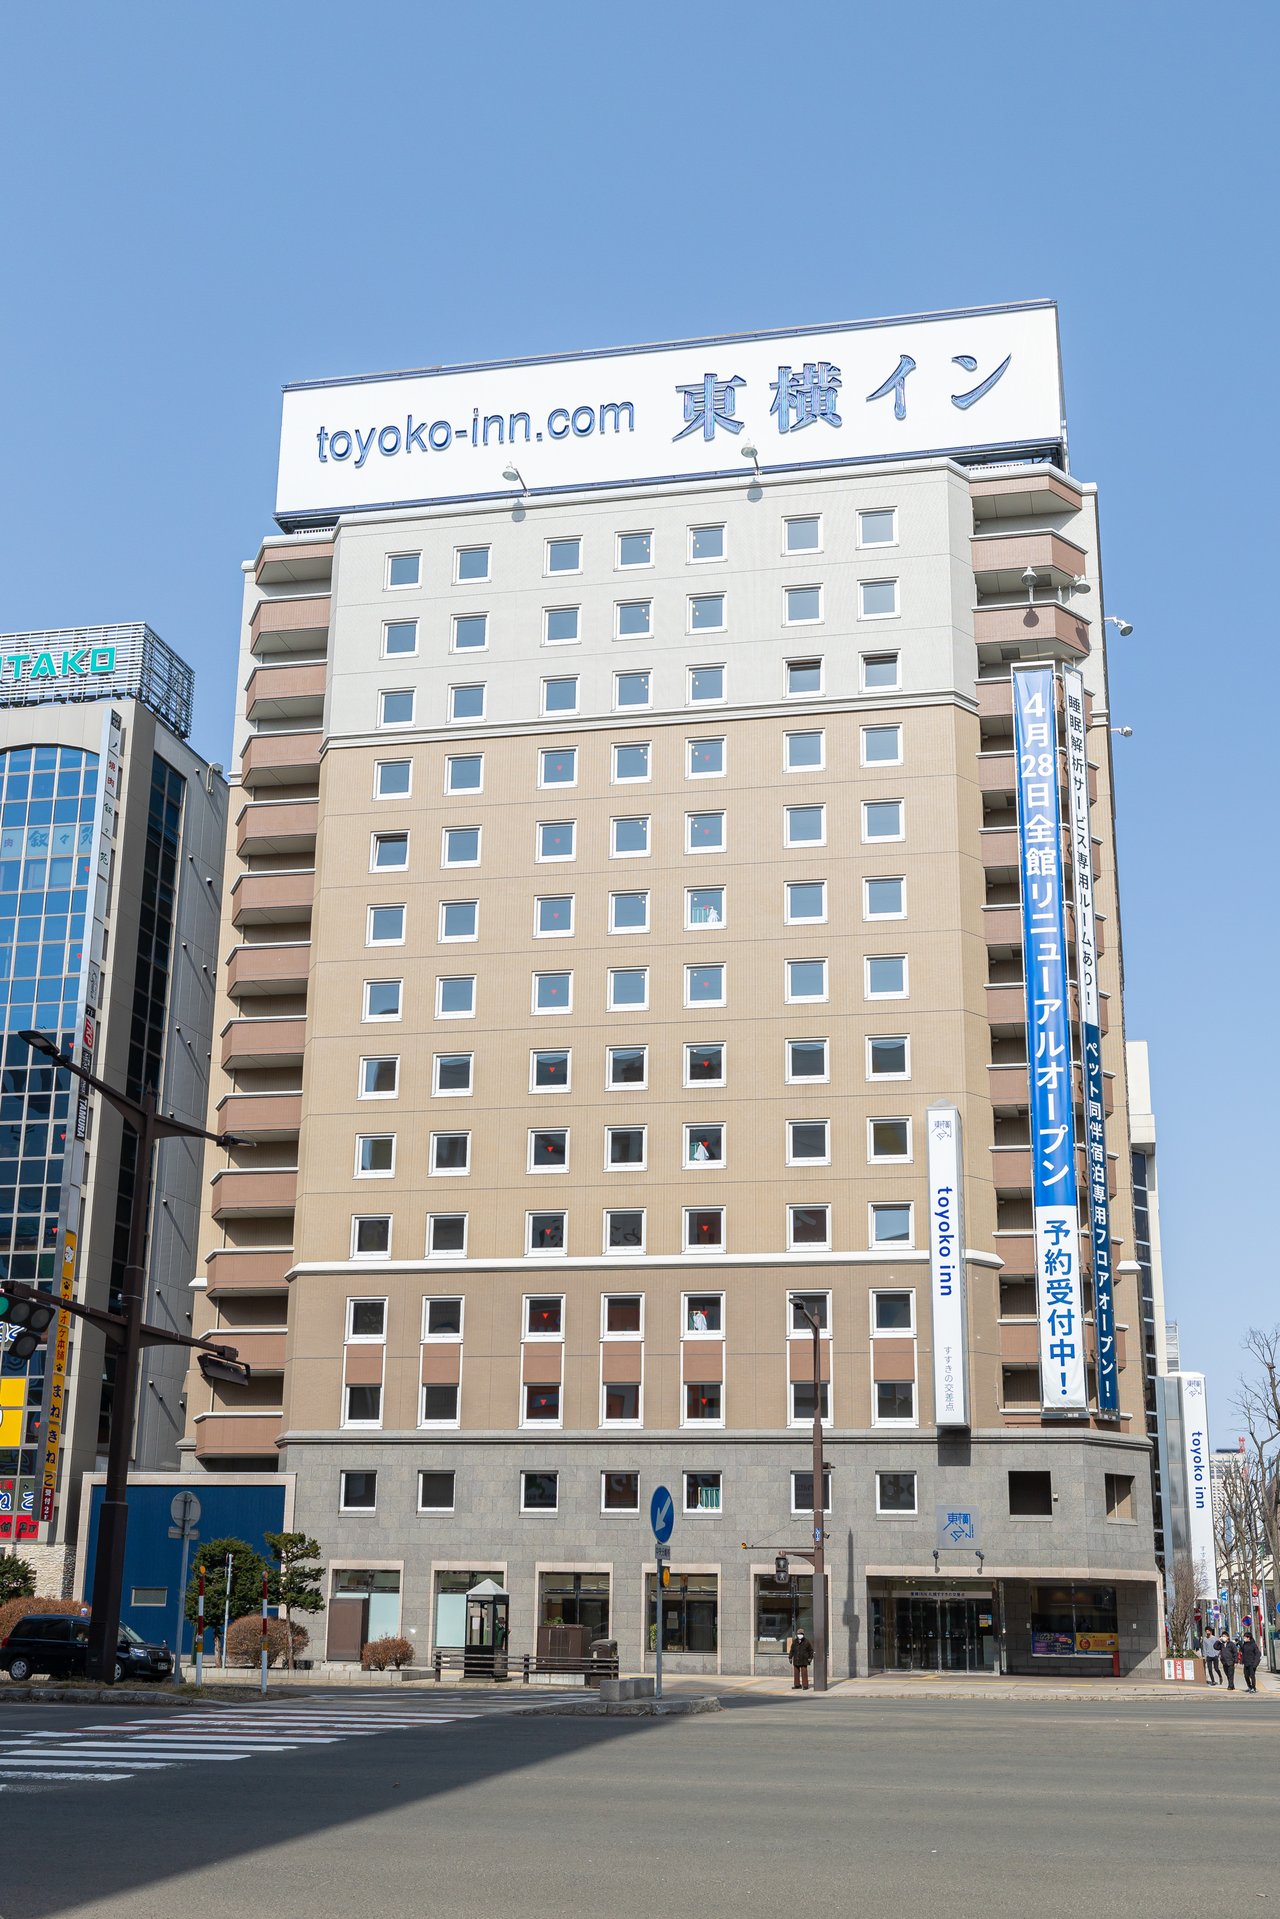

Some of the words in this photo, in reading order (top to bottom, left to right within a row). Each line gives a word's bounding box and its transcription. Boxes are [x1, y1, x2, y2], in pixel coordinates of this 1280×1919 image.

[672, 353, 1013, 442] 東横イン
[317, 398, 635, 468] toyoko-inn.com
[0, 646, 116, 680] TAKO
[1020, 692, 1070, 1188] 4月28日全館リニューアルオープン
[76, 1098, 88, 1138] TAMURA
[934, 1186, 954, 1257] toyoko
[940, 1265, 955, 1297] inn
[1044, 1219, 1076, 1396] 予約受付中!
[944, 1345, 955, 1412] すすきの交差点
[44, 1384, 63, 1488] まねきねこ
[1191, 1431, 1205, 1481] toyoko
[1195, 1486, 1207, 1510] inn
